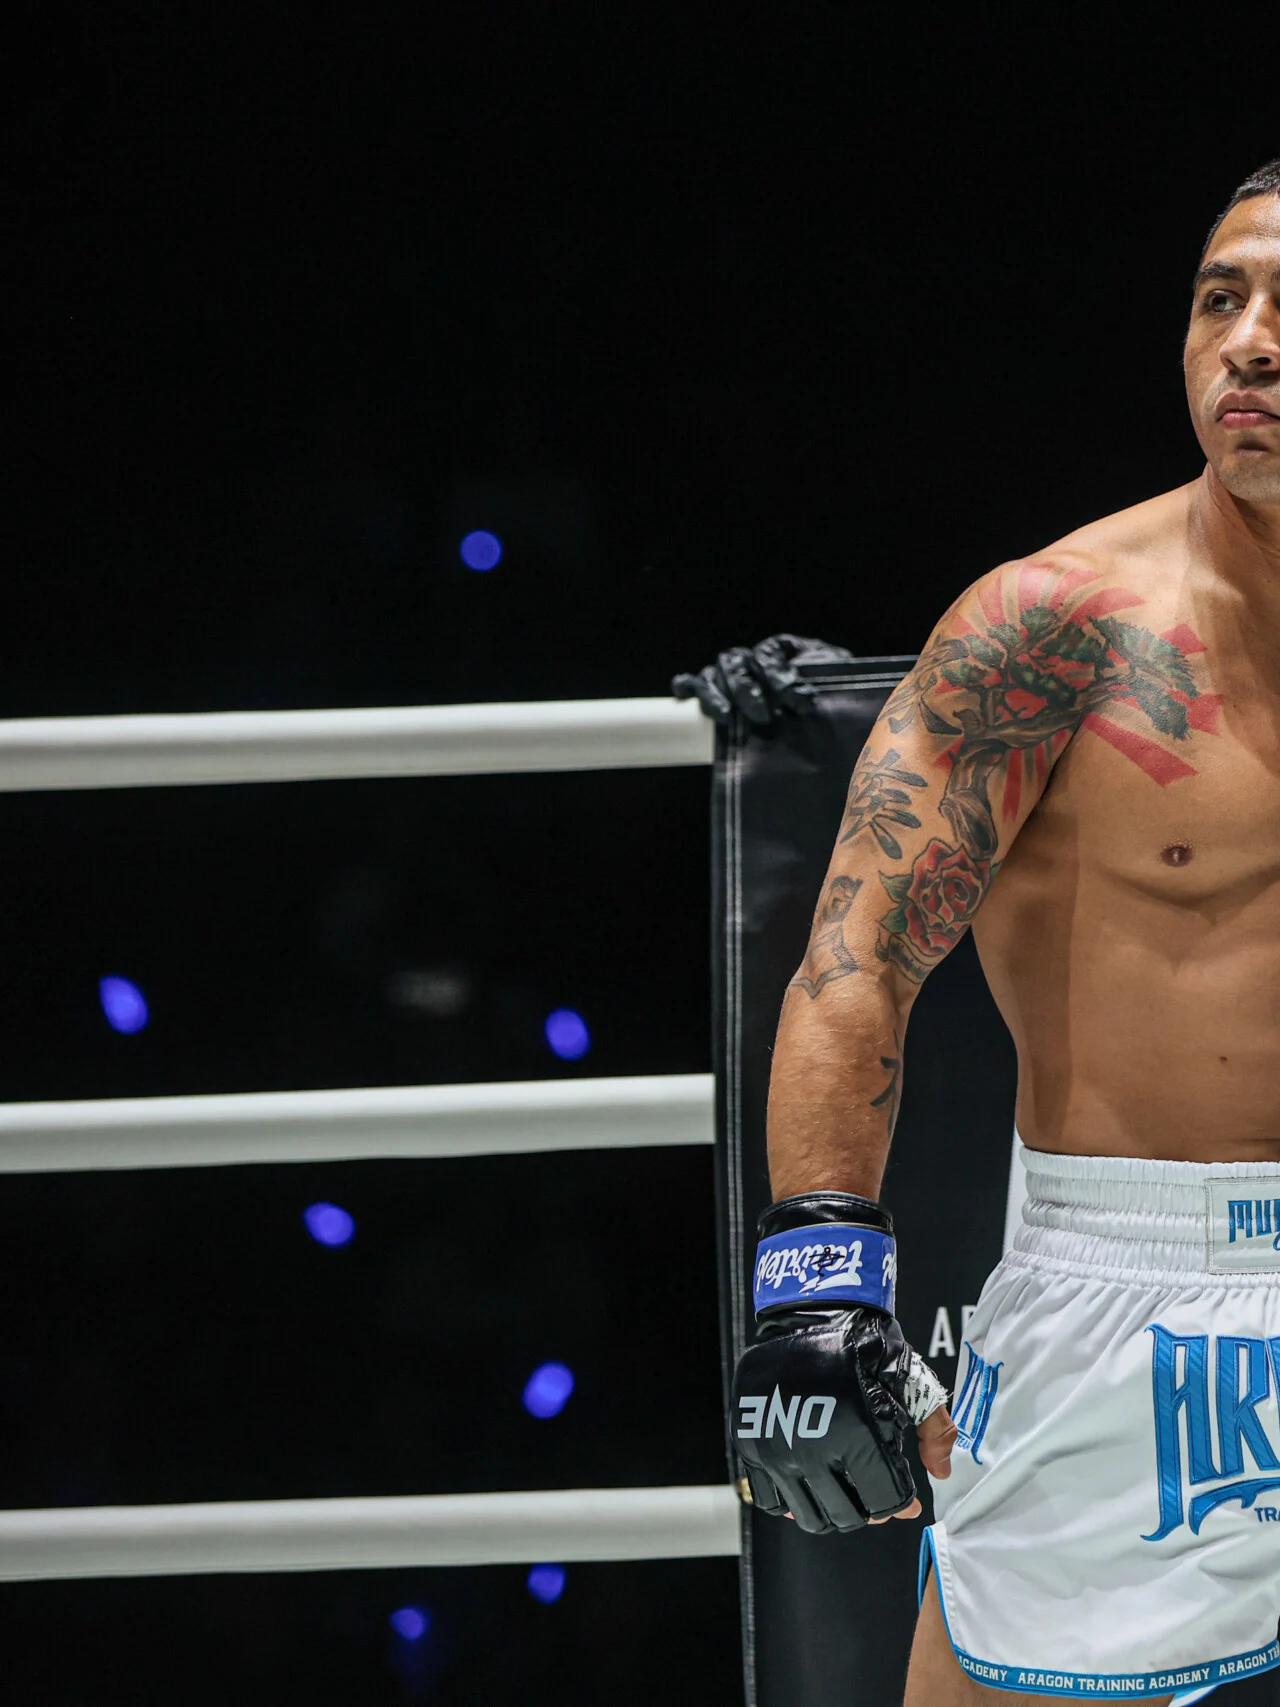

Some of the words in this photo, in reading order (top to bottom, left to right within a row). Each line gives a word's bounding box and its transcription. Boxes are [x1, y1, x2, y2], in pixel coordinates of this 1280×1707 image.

[755, 1240, 863, 1294] Fairtex
[737, 1383, 837, 1450] ONE
[1018, 1672, 1074, 1689] ARAGON
[1077, 1677, 1145, 1692] TRAINING
[1149, 1667, 1211, 1690] ACADEMY
[1218, 1654, 1268, 1677] ARAGON
